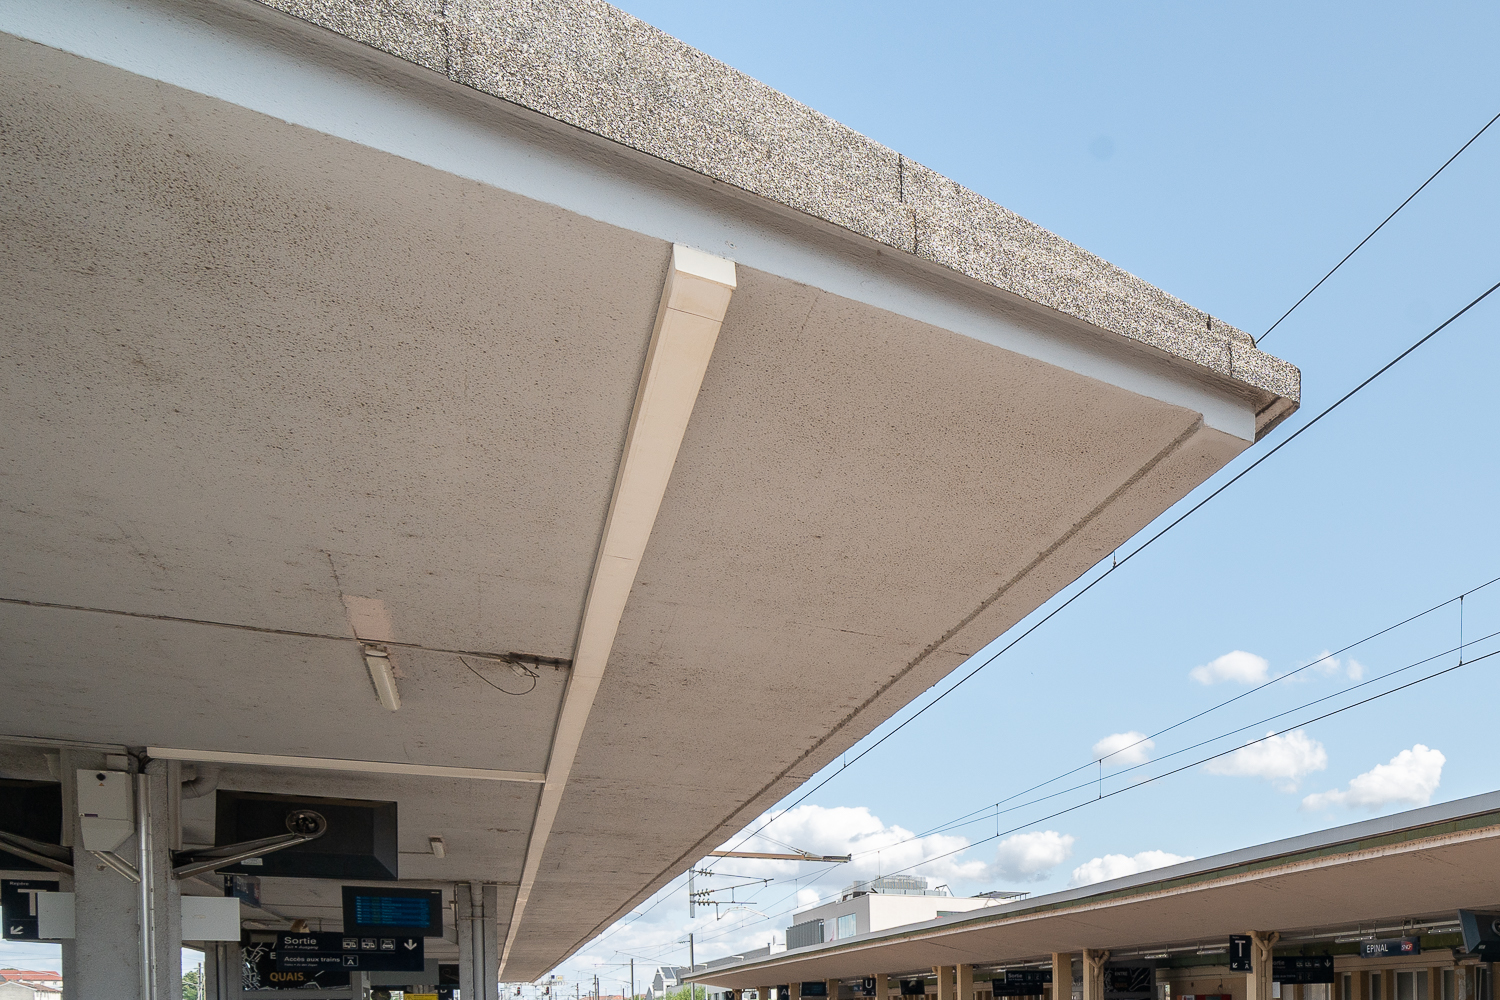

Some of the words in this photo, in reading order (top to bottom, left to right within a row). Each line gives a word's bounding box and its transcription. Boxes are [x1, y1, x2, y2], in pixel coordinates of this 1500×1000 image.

[17, 888, 47, 916] T
[284, 936, 316, 944] Sortie
[1234, 940, 1246, 957] T
[1366, 943, 1389, 953] EPINAL
[865, 980, 873, 989] U
